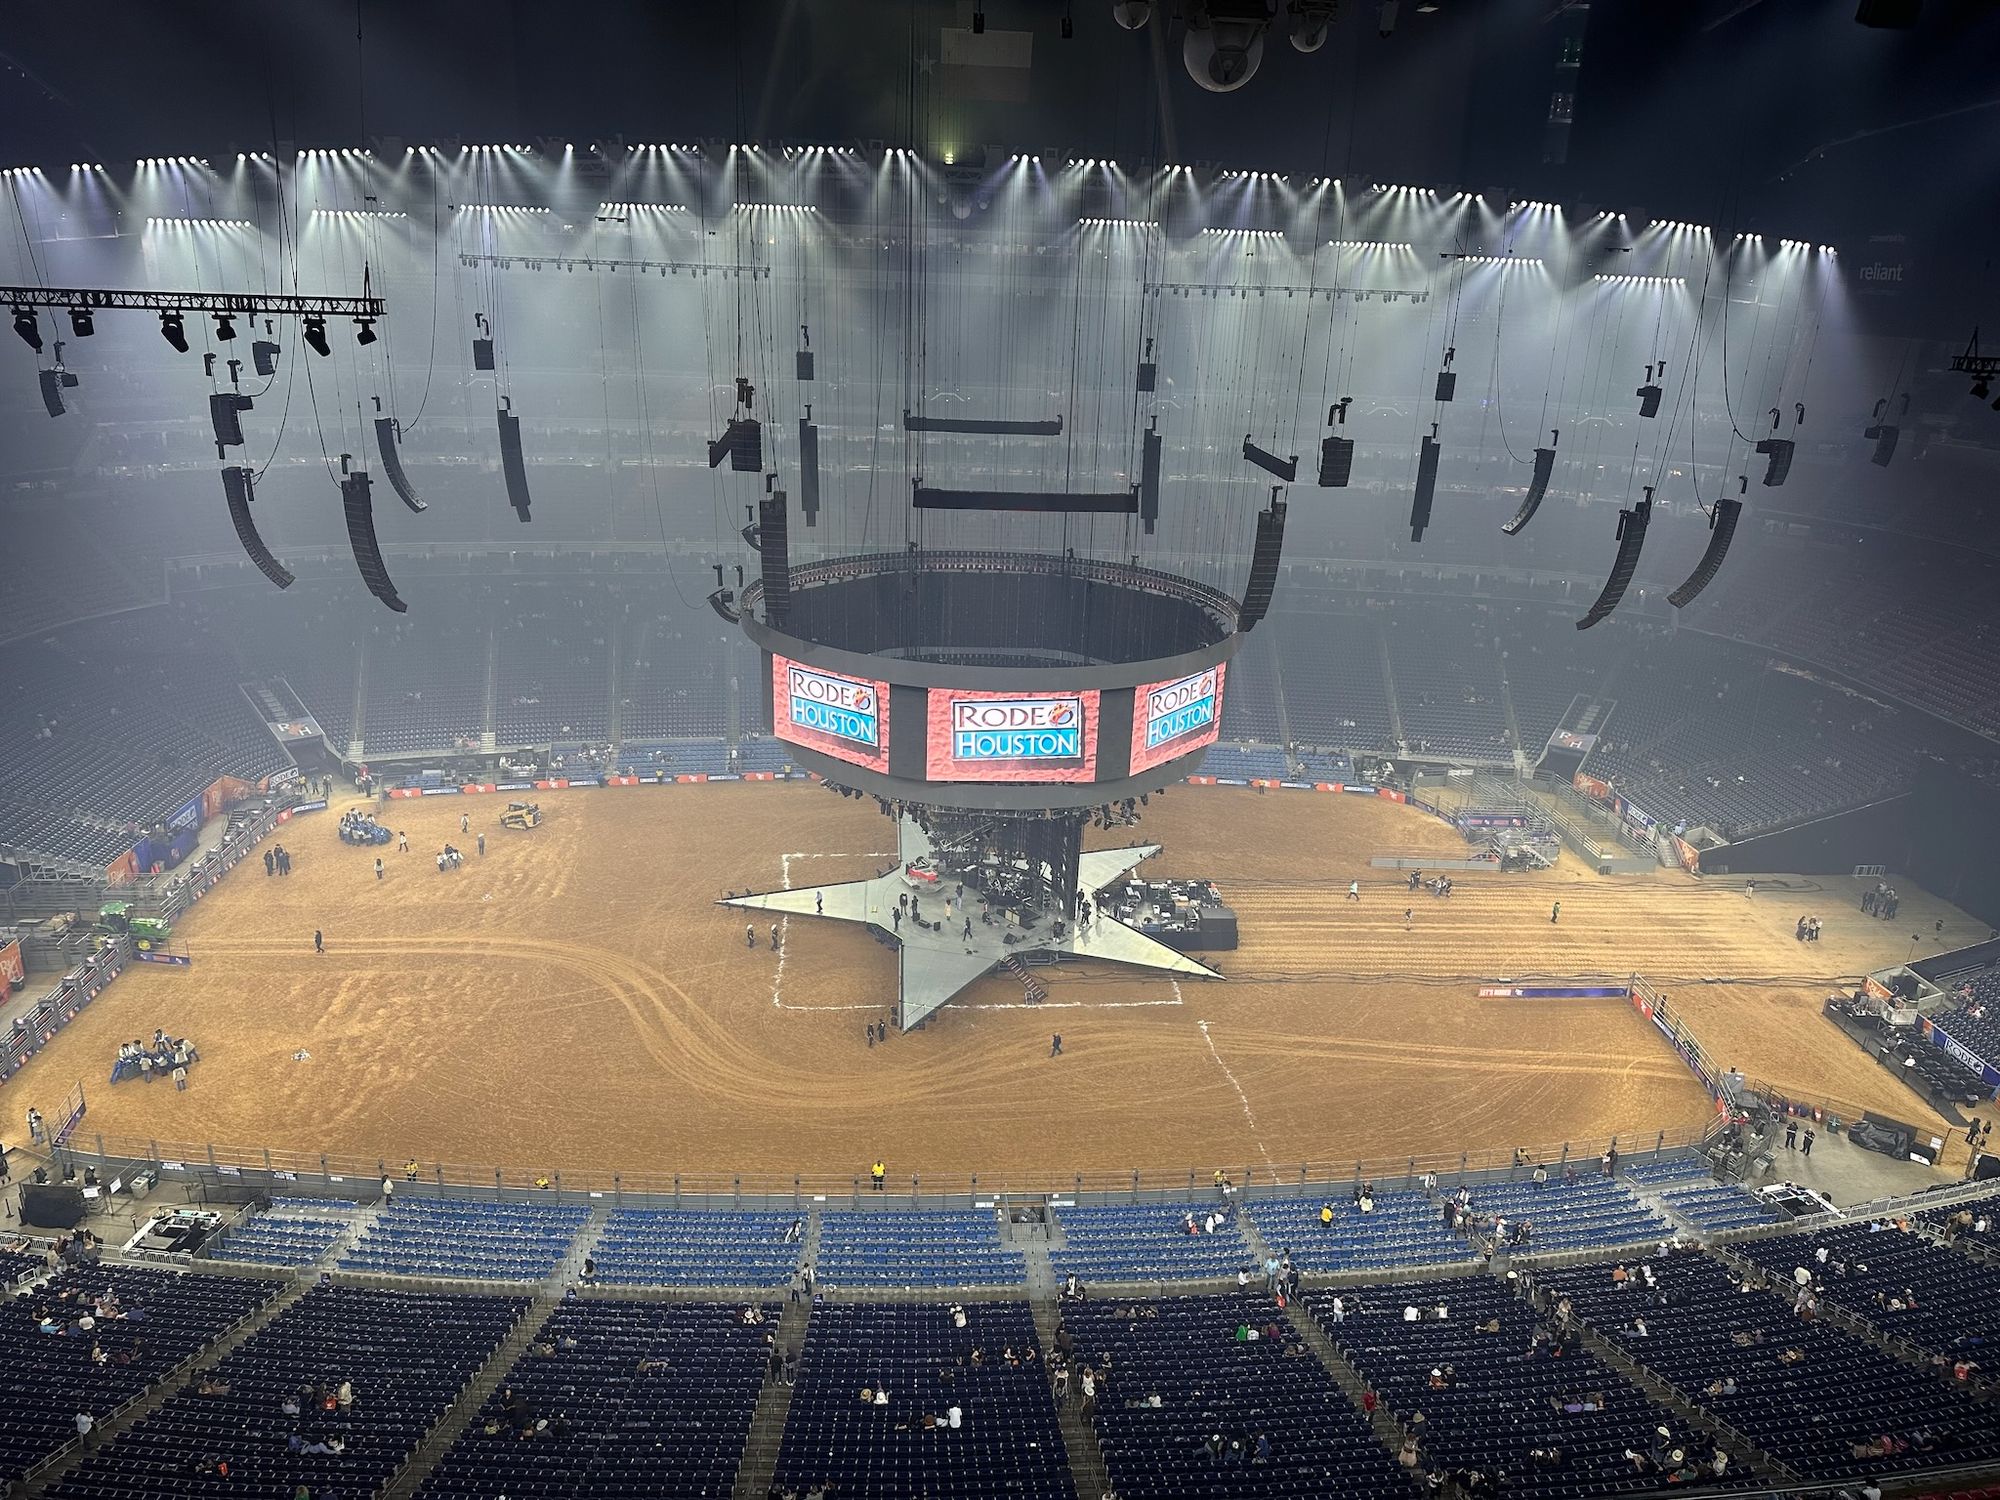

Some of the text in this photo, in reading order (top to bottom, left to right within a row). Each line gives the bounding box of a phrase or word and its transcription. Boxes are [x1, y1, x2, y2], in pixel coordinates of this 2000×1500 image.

[1859, 262, 1904, 281] reliant
[793, 672, 871, 711] RODEO
[1151, 676, 1213, 717] RODEO
[794, 699, 874, 741] HOUSTON
[958, 702, 1075, 728] RODEO
[1149, 699, 1213, 745] HOUSTON
[959, 731, 1075, 757] HOUSTON
